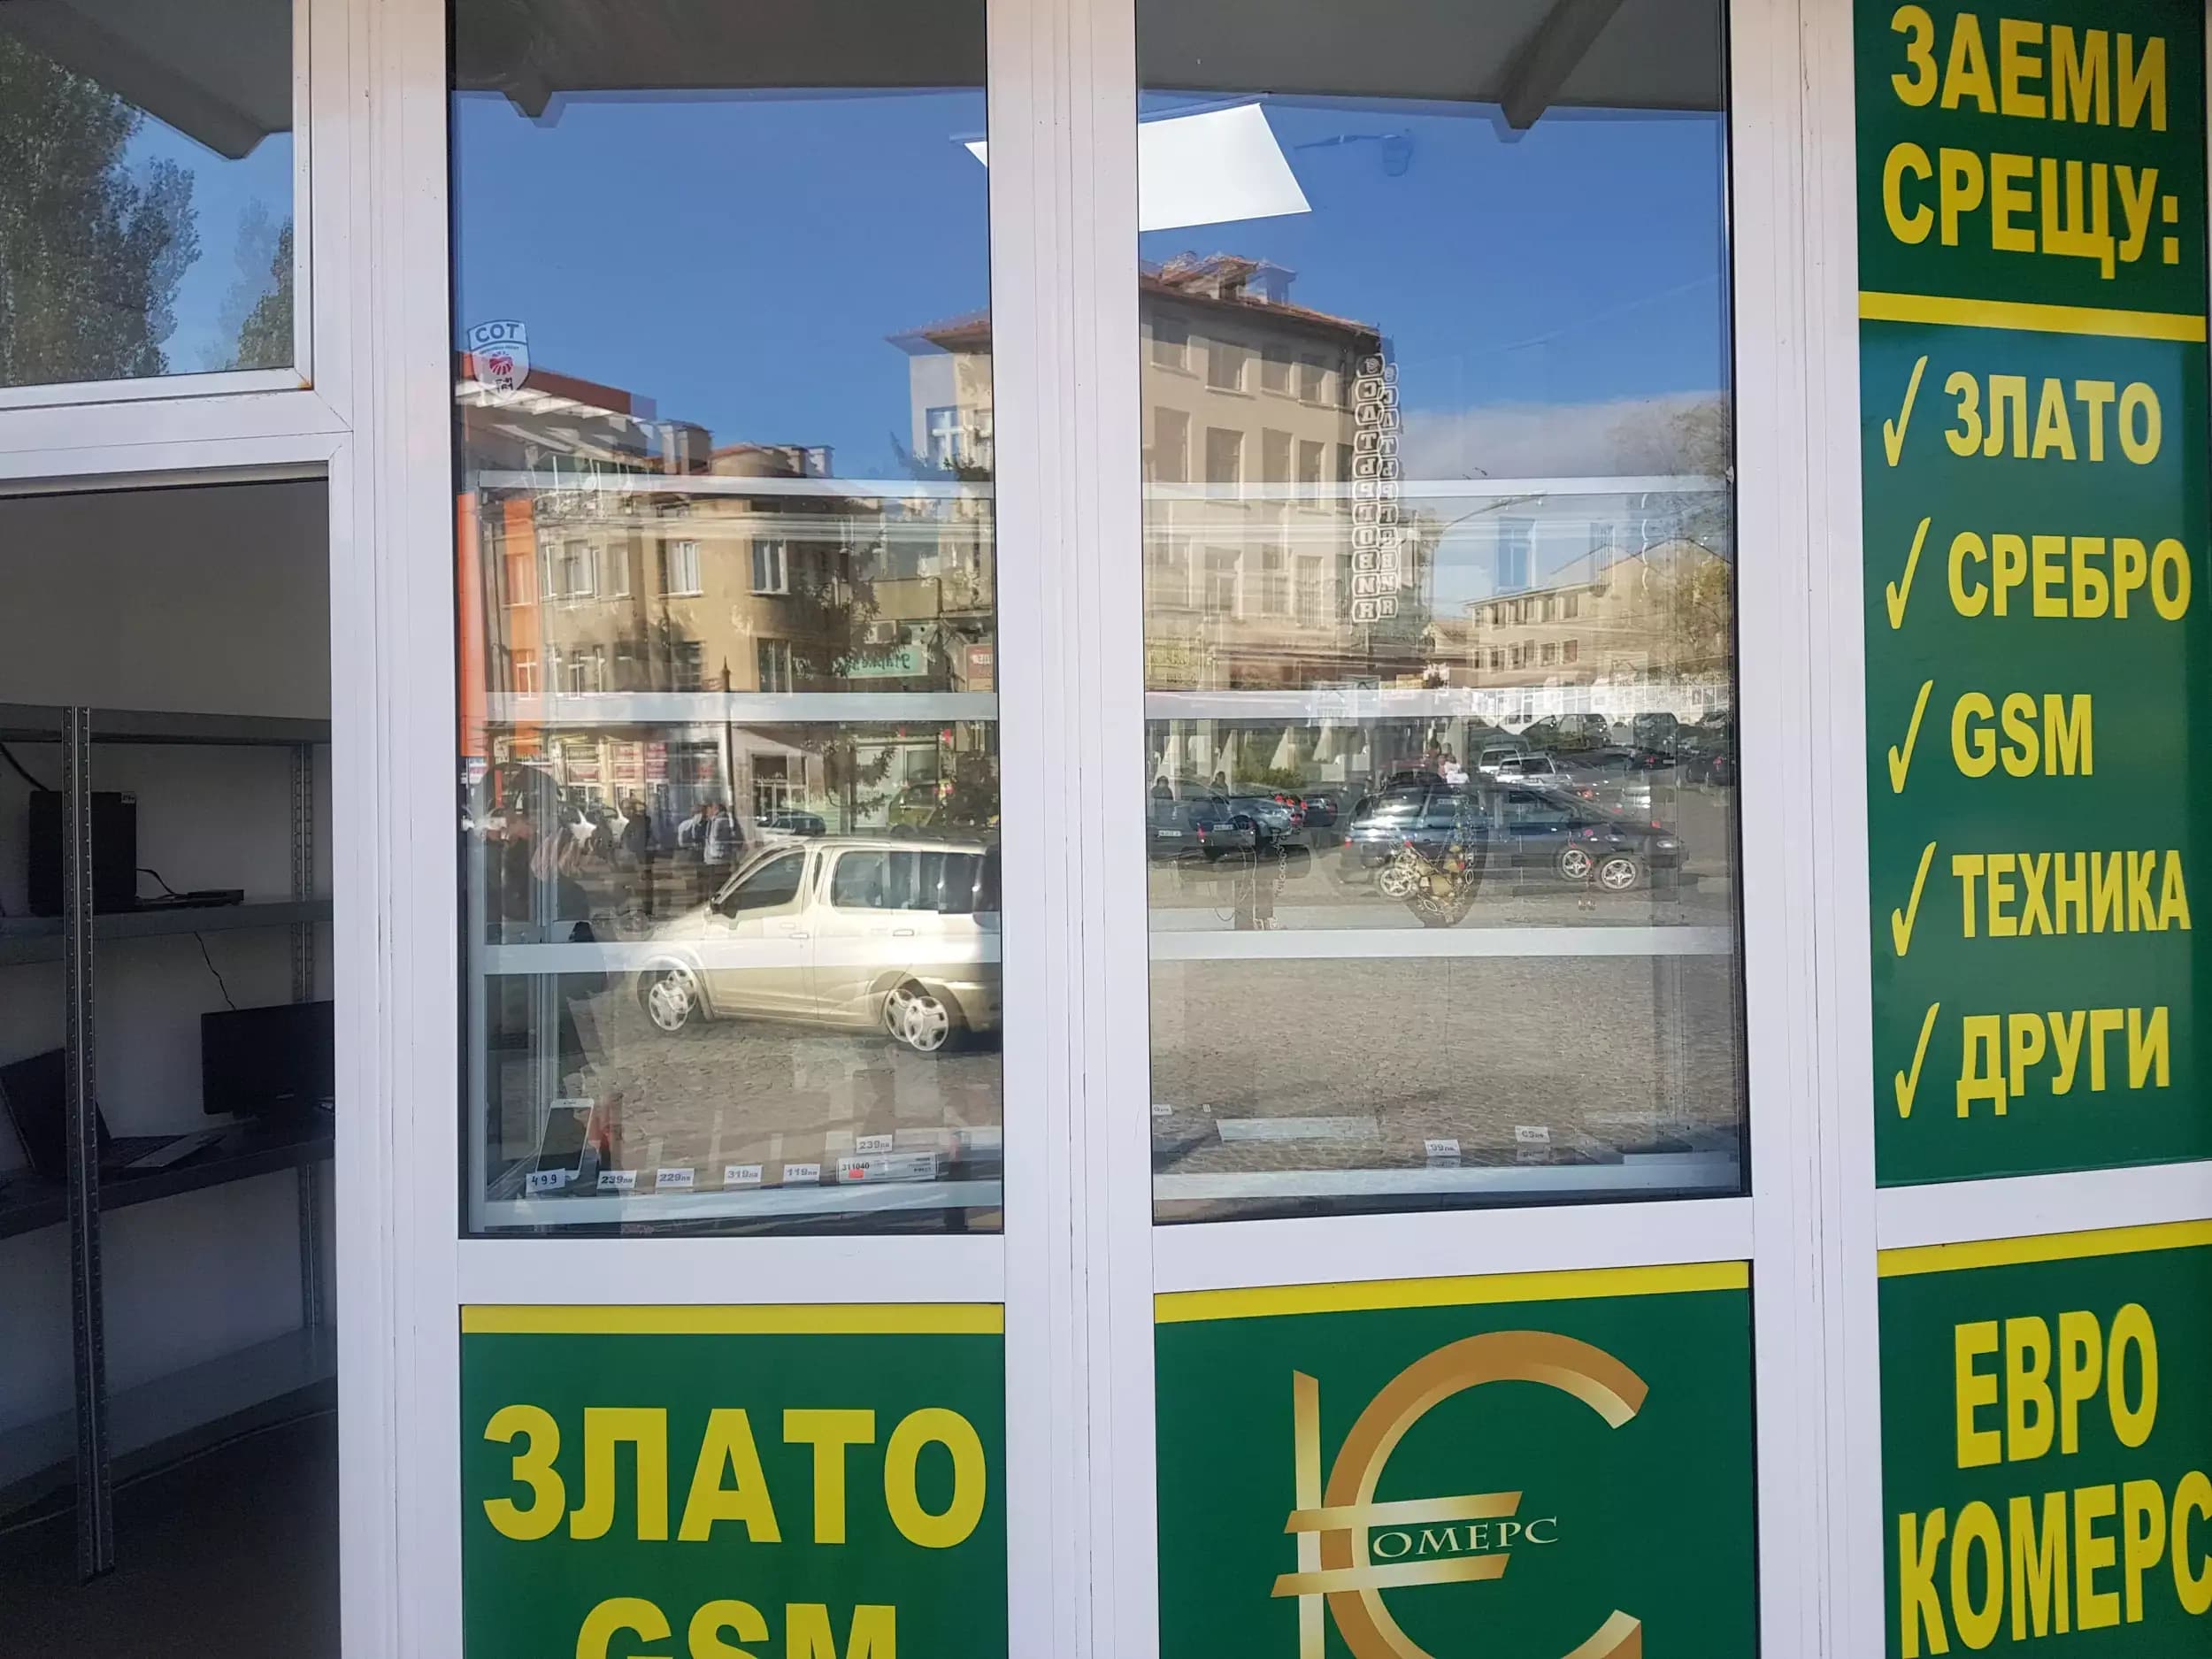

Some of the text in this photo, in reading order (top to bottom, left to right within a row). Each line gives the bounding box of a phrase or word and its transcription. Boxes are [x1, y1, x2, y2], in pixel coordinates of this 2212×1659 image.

[1891, 4, 2166, 131] ЗАЕМИ
[1883, 142, 2179, 280] СРЕЩУ:
[475, 323, 519, 342] СОТ
[1944, 371, 2162, 465] ЗЛАТО
[1948, 531, 2192, 621] СРЕБРО
[1951, 692, 2093, 778] GSM
[1952, 849, 2192, 938] ТЕХНИКА
[1956, 1006, 2170, 1118] ДРУГИ
[1955, 1303, 2158, 1469] ЕВРО
[483, 1405, 987, 1548] ЗЛАТО
[1372, 1516, 1558, 1559] ОМЕРС
[1899, 1471, 2212, 1659] КОМЕРС
